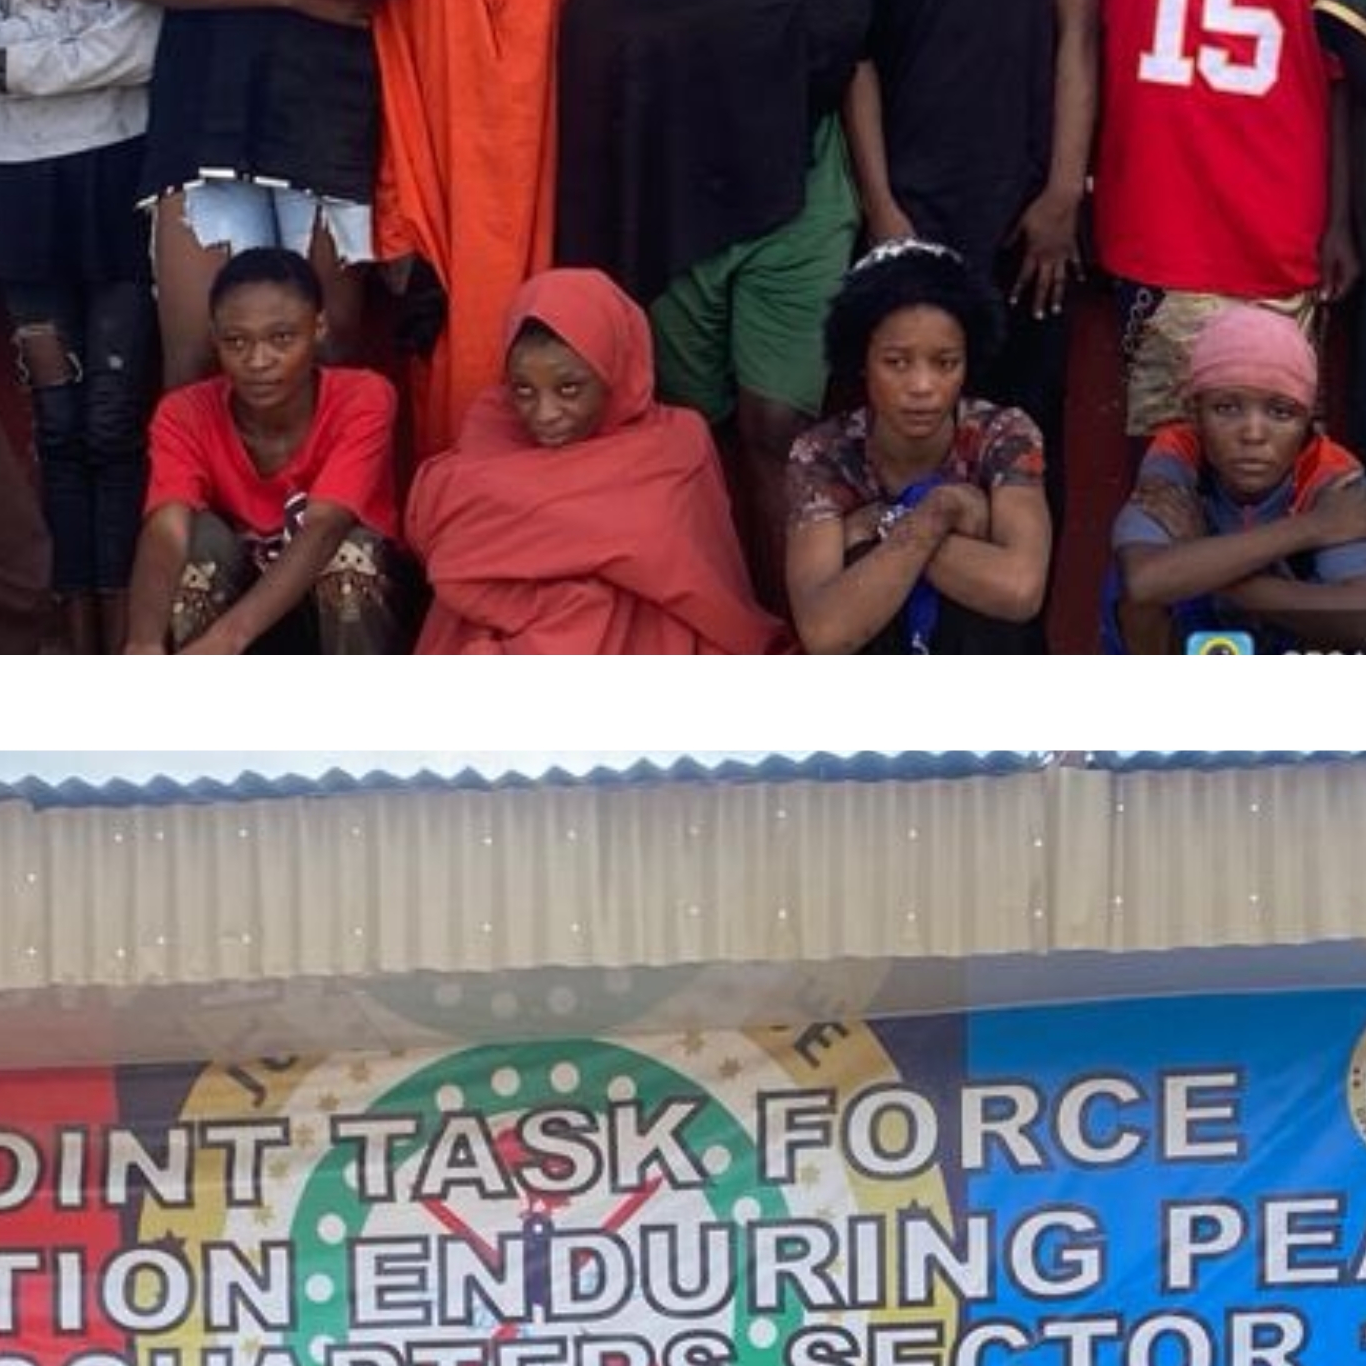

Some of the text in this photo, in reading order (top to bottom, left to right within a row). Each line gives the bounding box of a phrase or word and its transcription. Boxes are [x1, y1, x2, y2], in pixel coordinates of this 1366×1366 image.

[331, 1094, 719, 1205] TASK
[755, 1065, 1246, 1189] FORCE
[345, 1204, 1105, 1330] ENDURING
